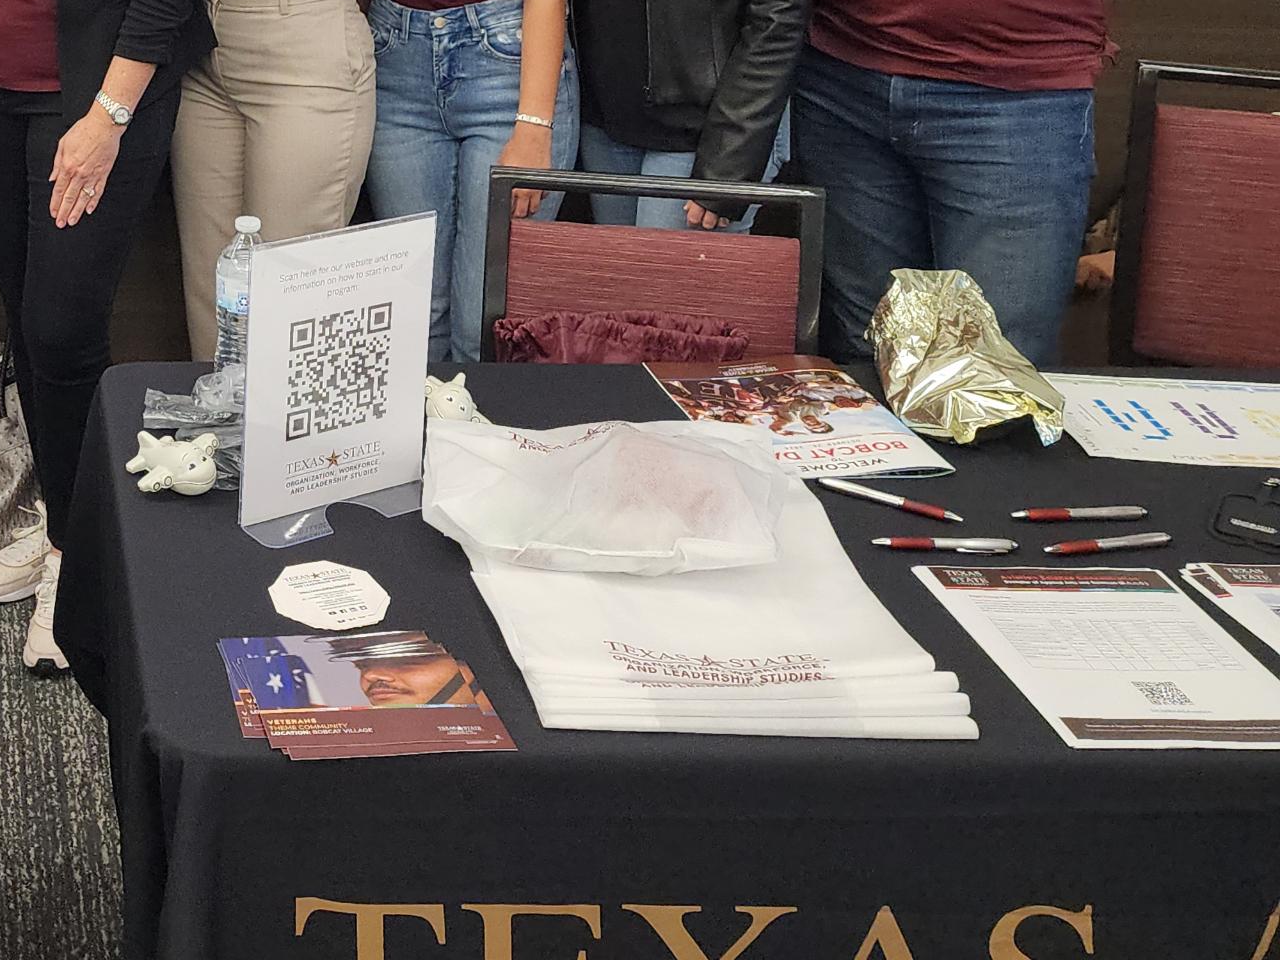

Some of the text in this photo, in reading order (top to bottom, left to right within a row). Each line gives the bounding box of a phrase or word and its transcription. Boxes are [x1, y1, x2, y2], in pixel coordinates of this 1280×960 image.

[279, 250, 409, 283] Scan here for our website and more
[283, 279, 325, 294] information
[326, 276, 337, 285] on
[338, 273, 355, 282] how
[356, 271, 364, 279] to
[365, 268, 382, 277] start
[382, 265, 390, 273] in
[286, 440, 381, 474] TEXAS STATE
[811, 440, 909, 460] BOBCAT
[798, 457, 888, 473] WELCOME
[290, 466, 378, 495] AND LEADERSHIP STUDIES
[943, 569, 983, 578] TEXAS
[603, 640, 817, 668] TEXAS STATE
[626, 664, 658, 674] AND
[663, 667, 754, 685] LEADERSHIP
[760, 672, 823, 684] STUDIES
